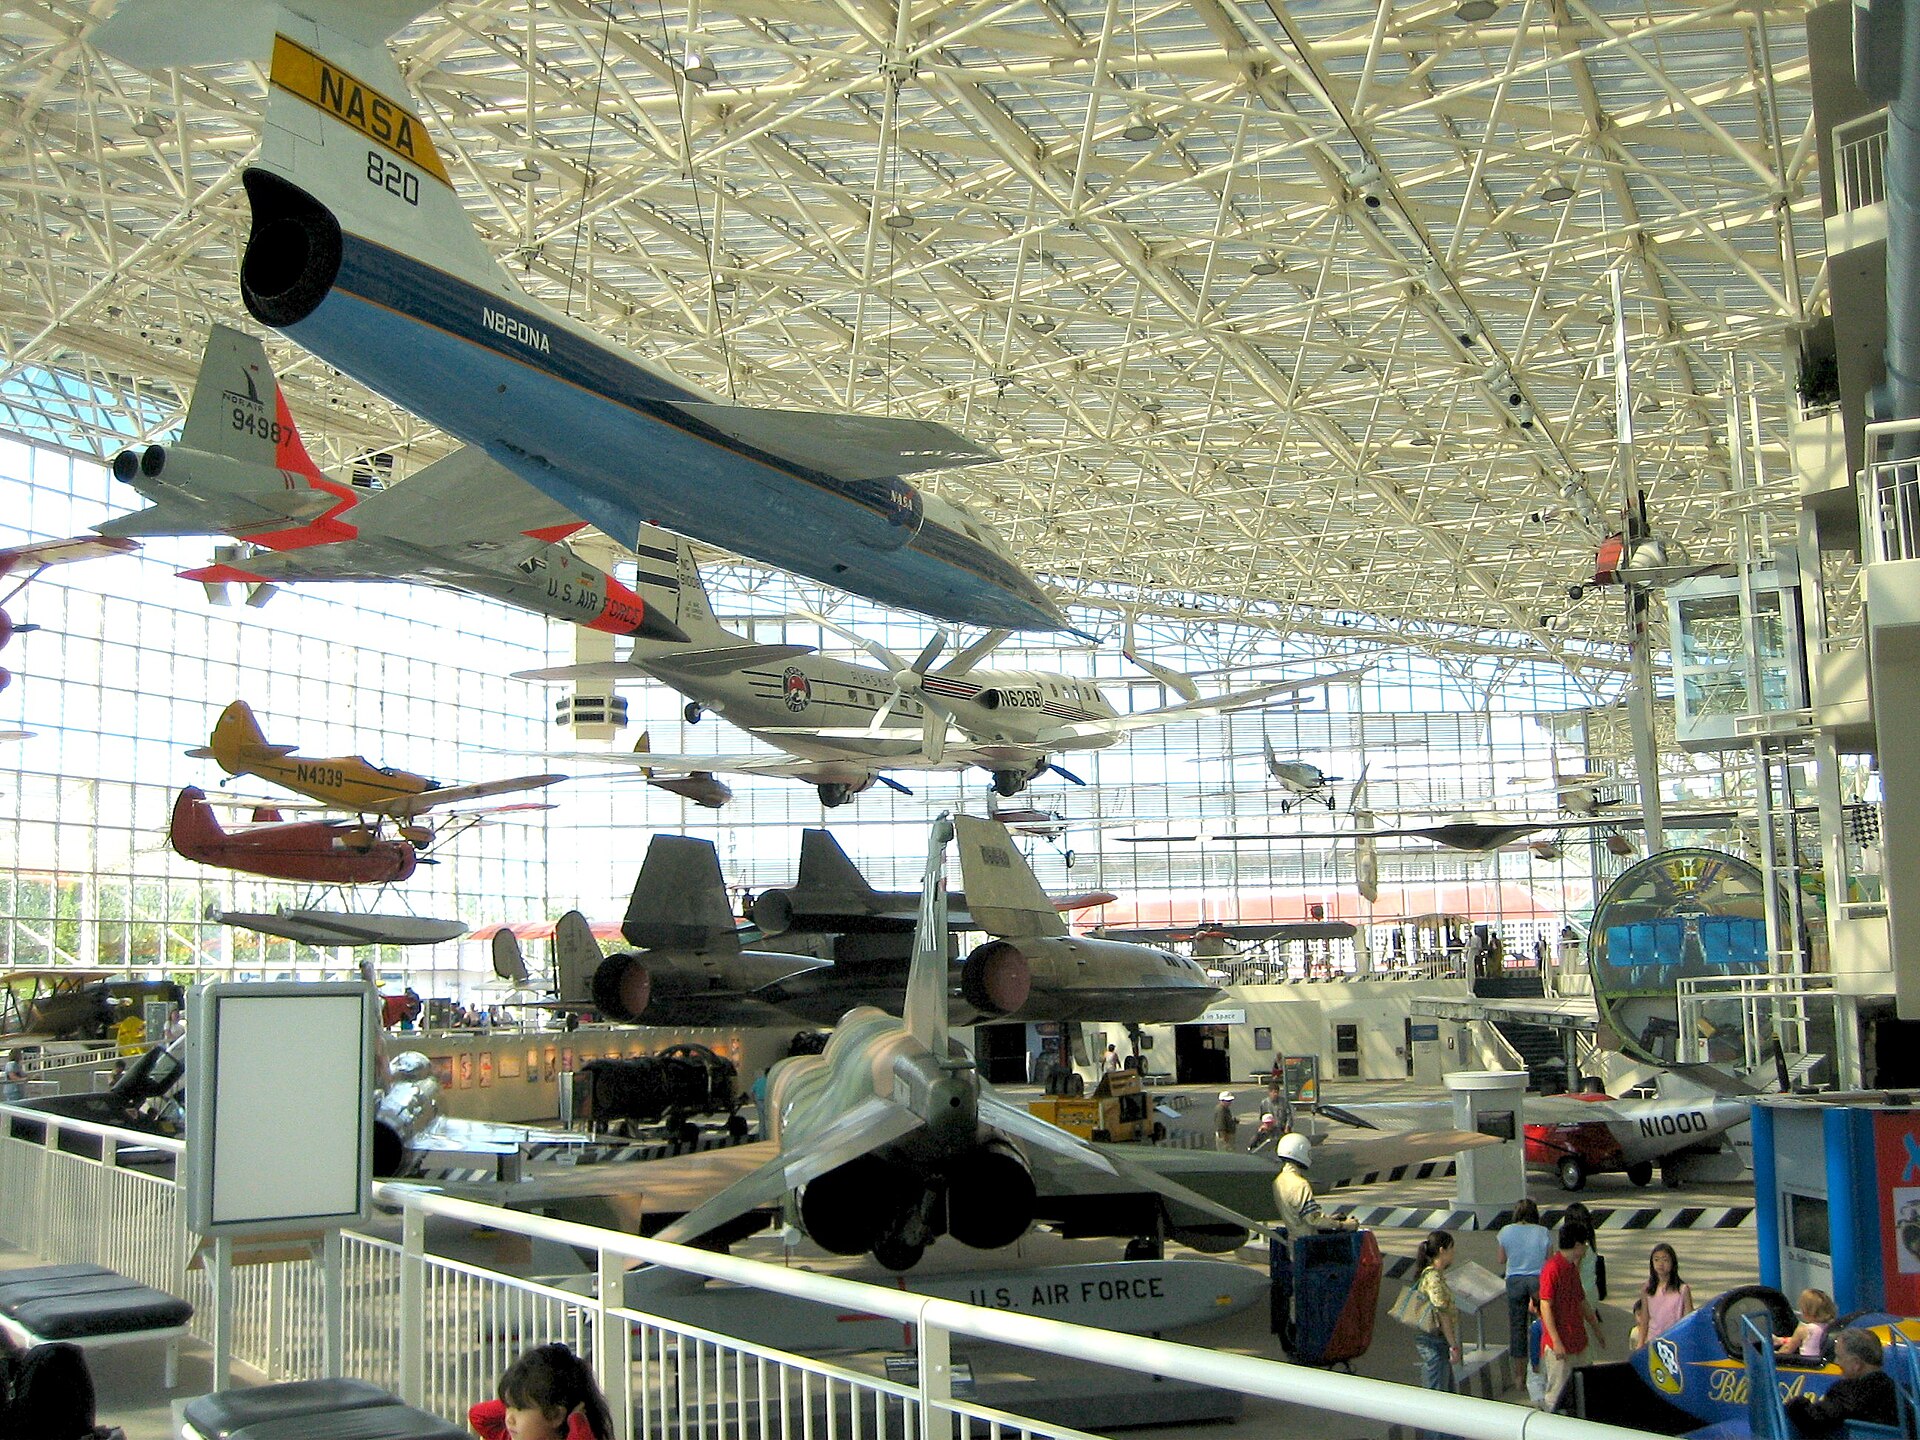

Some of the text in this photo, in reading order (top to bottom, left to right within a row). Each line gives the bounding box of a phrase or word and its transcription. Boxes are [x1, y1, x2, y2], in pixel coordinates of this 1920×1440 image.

[319, 66, 415, 157] NASA
[367, 151, 419, 206] 820
[482, 306, 550, 354] N820NA
[222, 392, 265, 414] NORAIR
[232, 408, 293, 448] 94987
[576, 589, 598, 612] AIR
[600, 596, 641, 626] FORCE
[297, 763, 343, 788] N4339
[1640, 1111, 1708, 1138] N100D
[1032, 1284, 1069, 1306] AIR
[1081, 1278, 1164, 1303] FORCE
